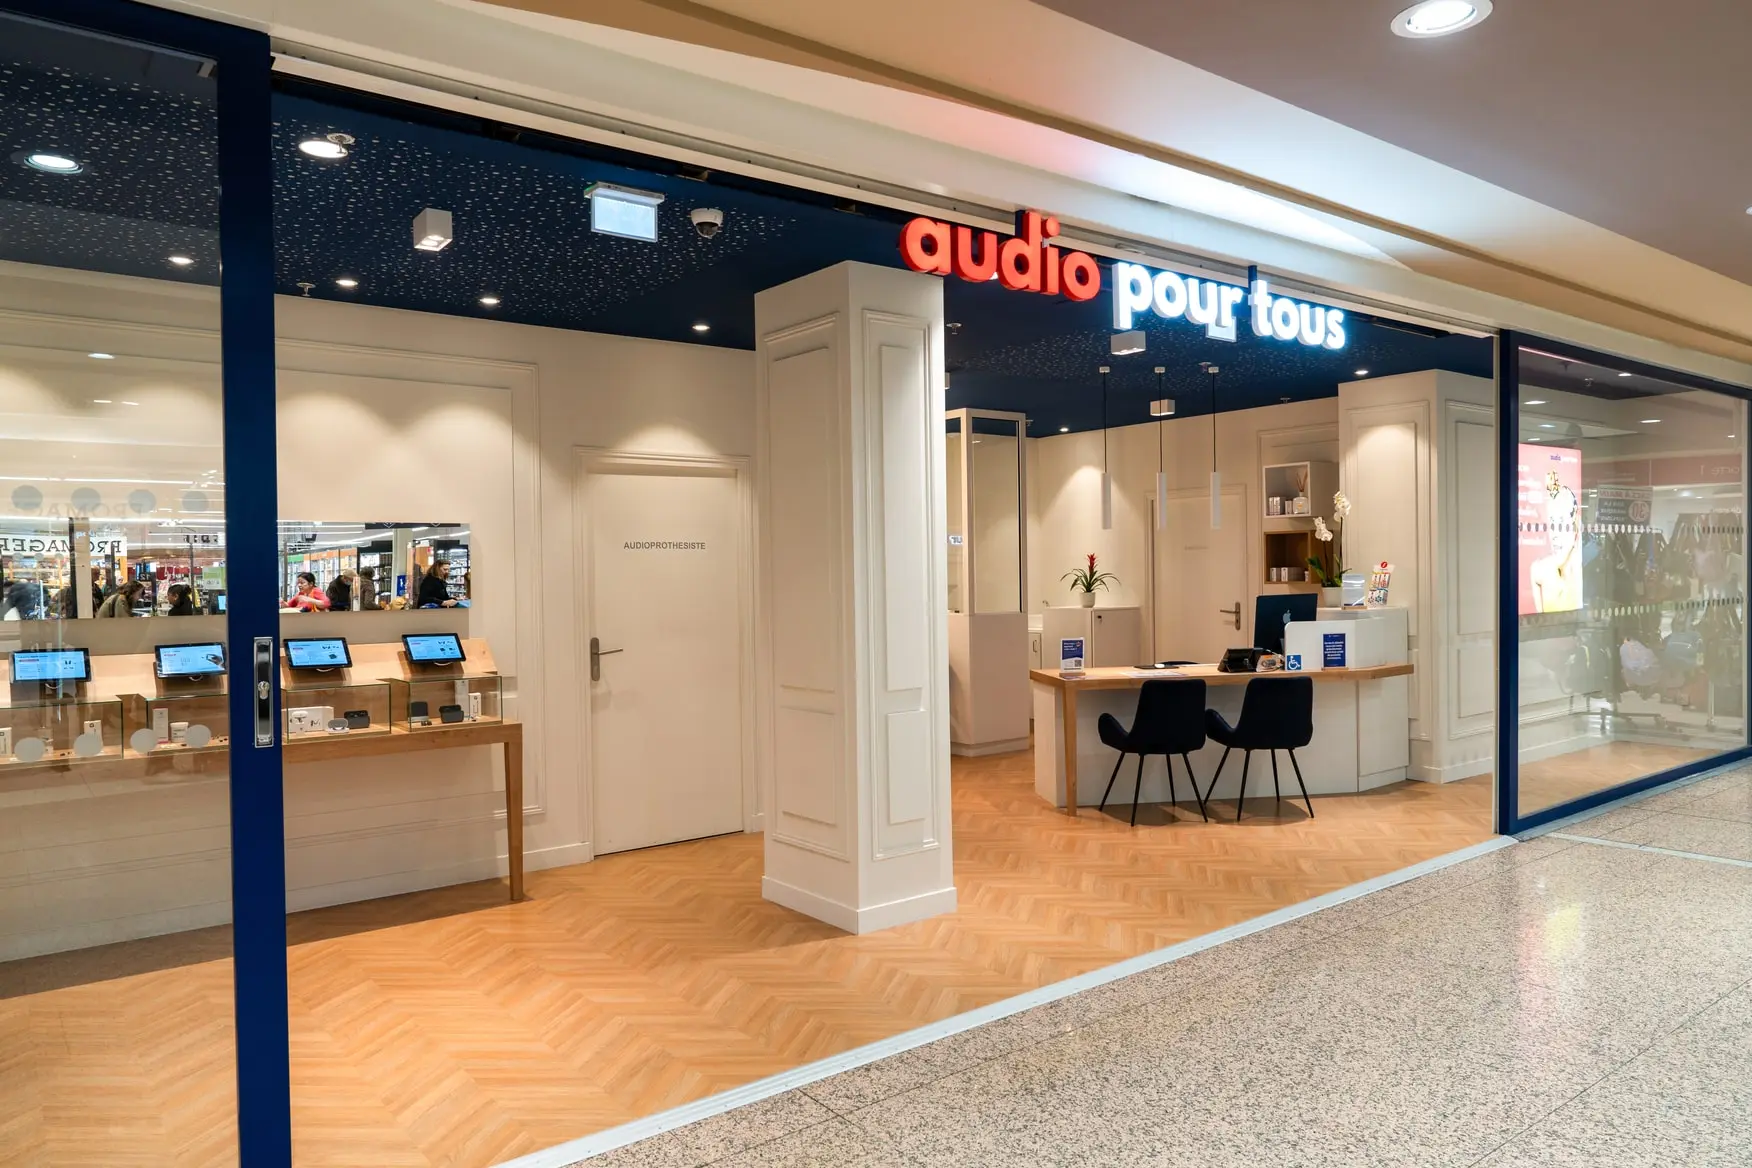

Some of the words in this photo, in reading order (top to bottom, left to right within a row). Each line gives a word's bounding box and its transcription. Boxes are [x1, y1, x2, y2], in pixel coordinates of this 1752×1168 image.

[900, 210, 1100, 301] audio
[1112, 262, 1243, 330] pour
[1248, 279, 1345, 349] tous
[623, 541, 706, 550] AUDIOPROTHESISTE
